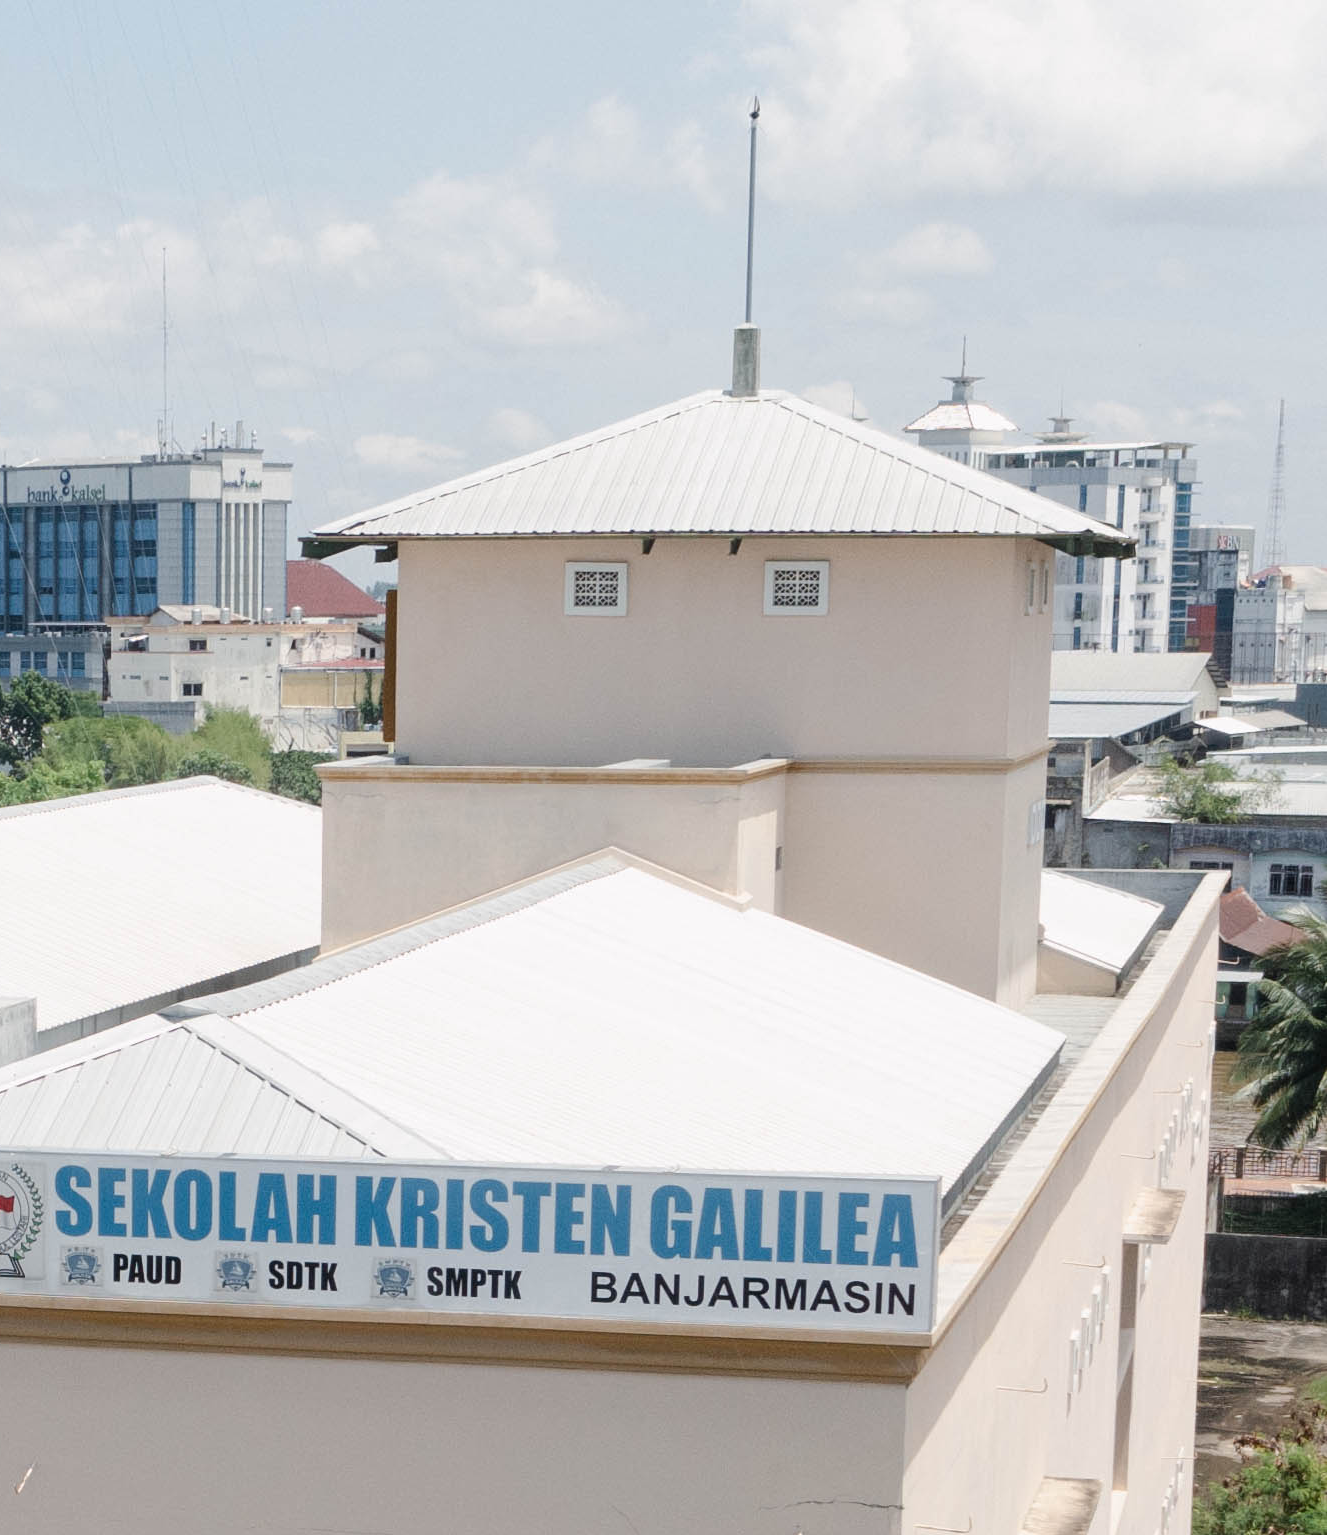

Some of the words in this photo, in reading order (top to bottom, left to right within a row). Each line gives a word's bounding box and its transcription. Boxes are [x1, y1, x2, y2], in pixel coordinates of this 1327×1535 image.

[27, 485, 58, 503] bank
[71, 484, 106, 502] kalsel
[54, 1165, 337, 1246] SEKOLAH
[355, 1175, 632, 1257] KRISTEN
[650, 1184, 920, 1268] GALILEA
[113, 1253, 182, 1285] PAUD
[268, 1260, 338, 1292] SDTK
[427, 1266, 523, 1300] SMPTK
[590, 1271, 916, 1316] BANJARMASIN
